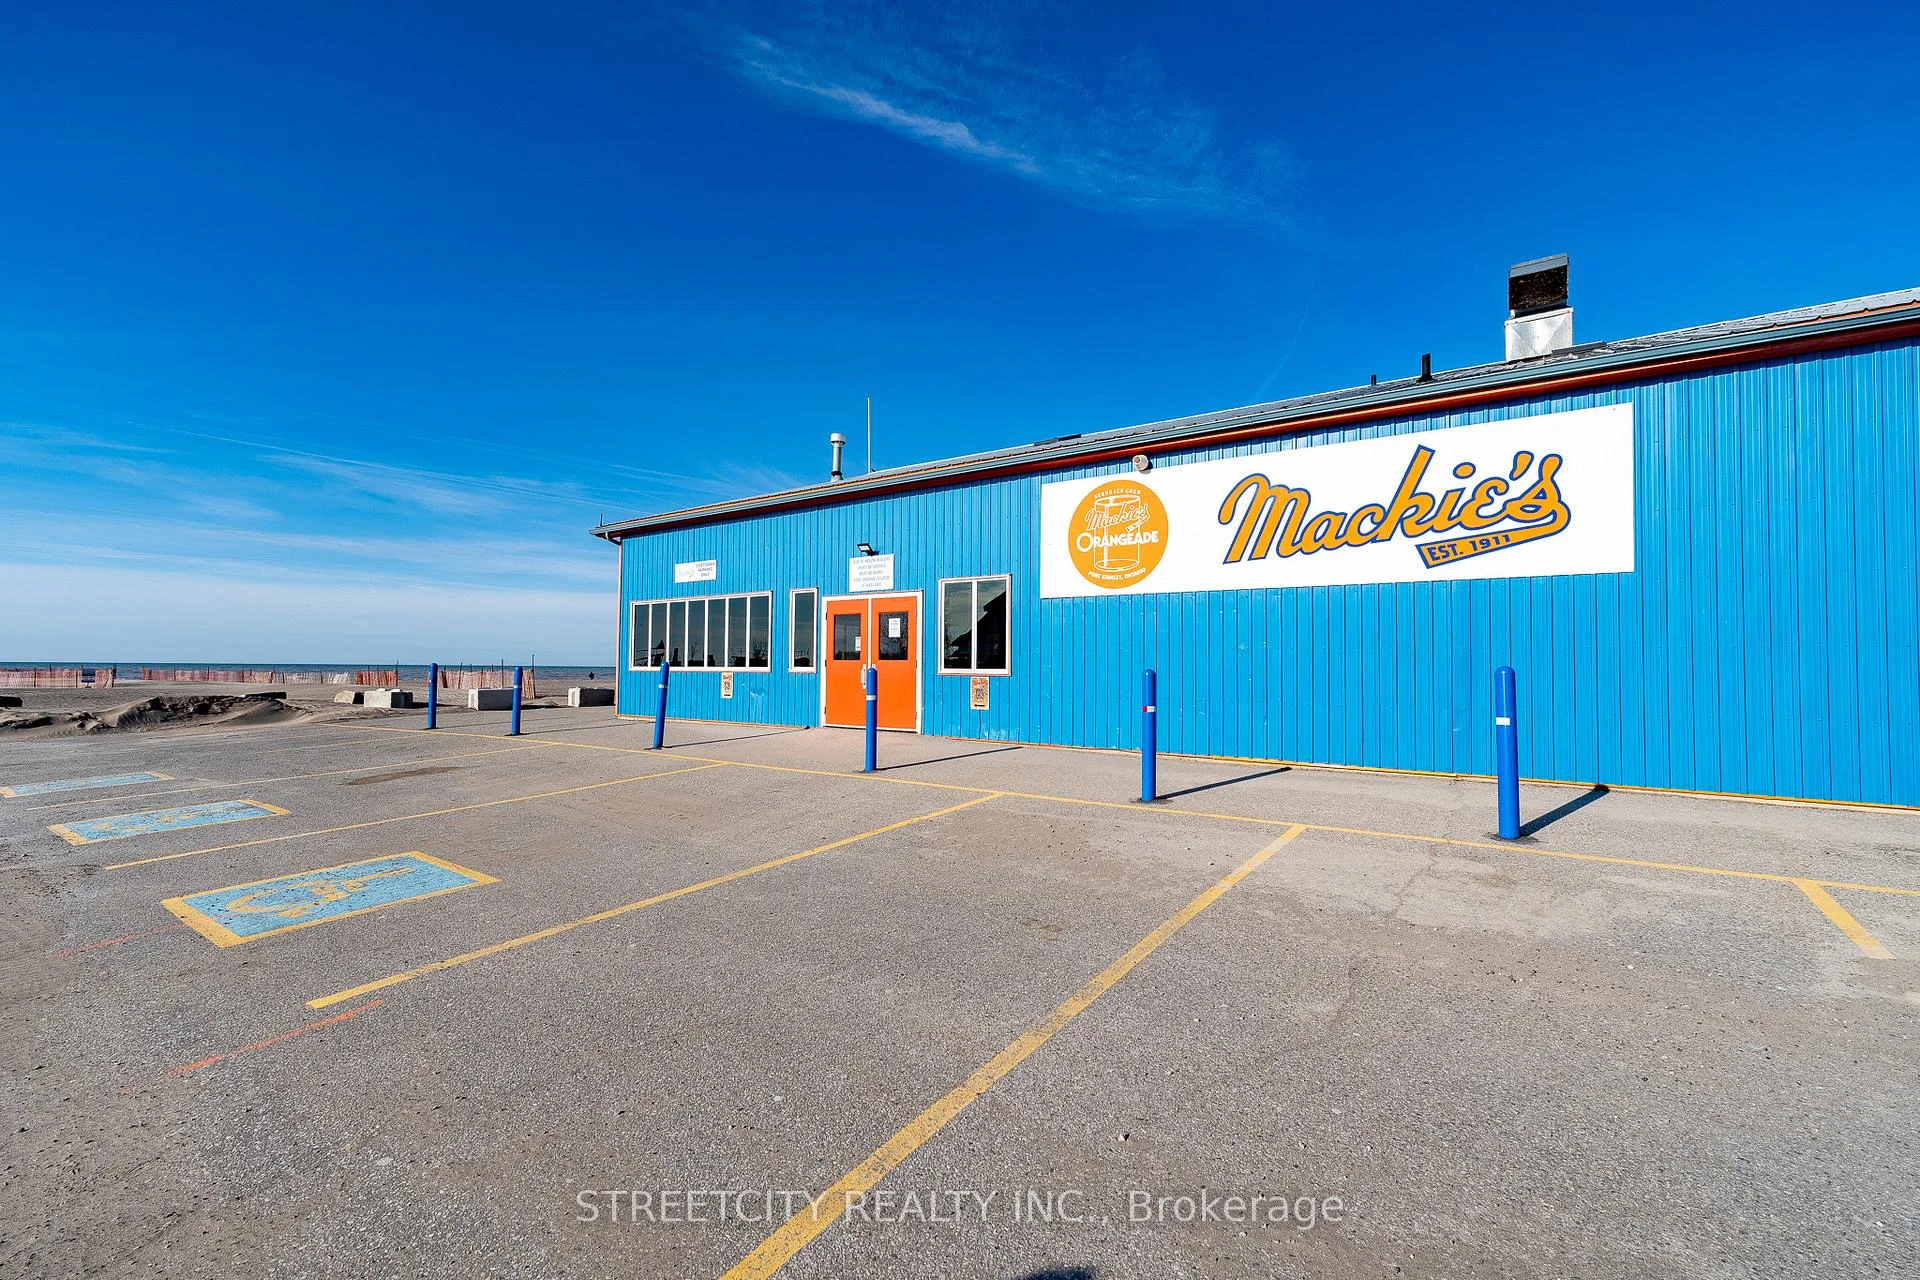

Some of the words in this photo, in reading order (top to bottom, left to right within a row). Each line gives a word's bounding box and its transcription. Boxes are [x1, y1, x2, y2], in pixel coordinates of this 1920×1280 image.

[1094, 489, 1112, 499] SERVE
[1218, 444, 1571, 565] Mackie's
[1085, 503, 1150, 531] Mackie's
[1426, 543, 1464, 562] EST.
[1469, 534, 1511, 552] 1911
